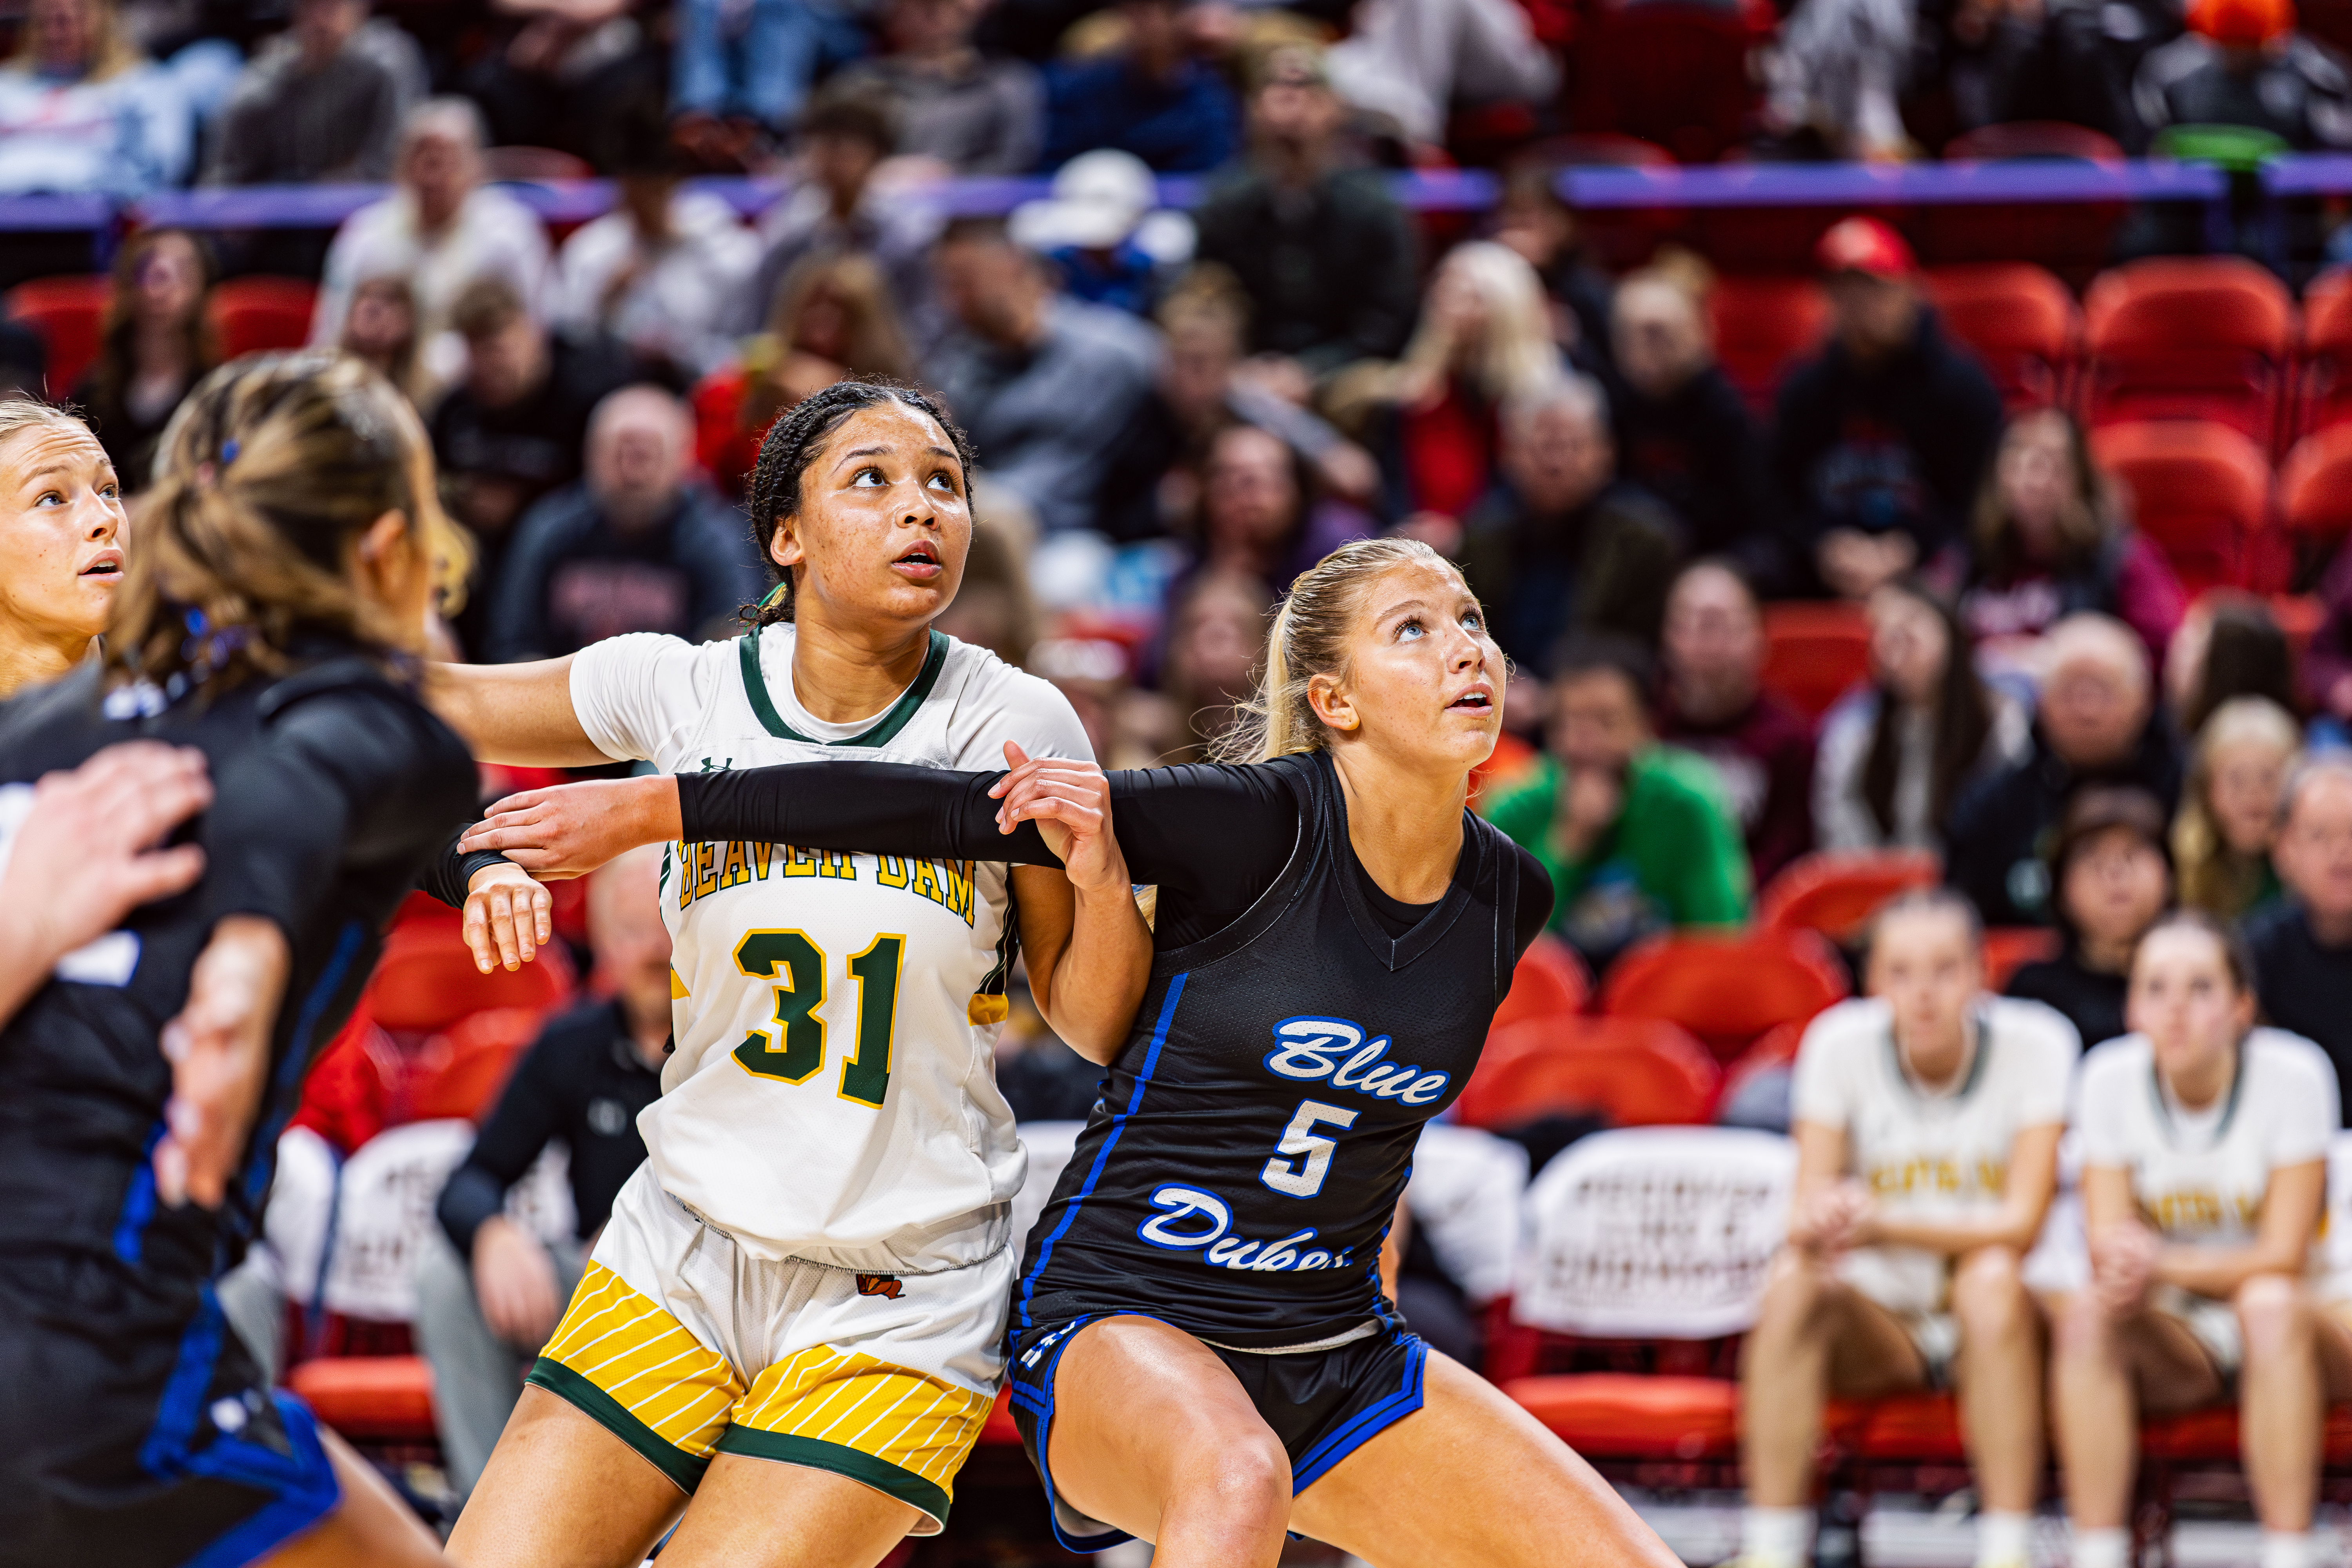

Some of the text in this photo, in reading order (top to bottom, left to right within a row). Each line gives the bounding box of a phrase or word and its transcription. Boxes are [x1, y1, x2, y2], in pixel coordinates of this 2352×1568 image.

[876, 852, 975, 930] DAM
[730, 928, 907, 1110] 31
[1263, 1015, 1451, 1107] Blue
[1258, 1098, 1362, 1200] 5
